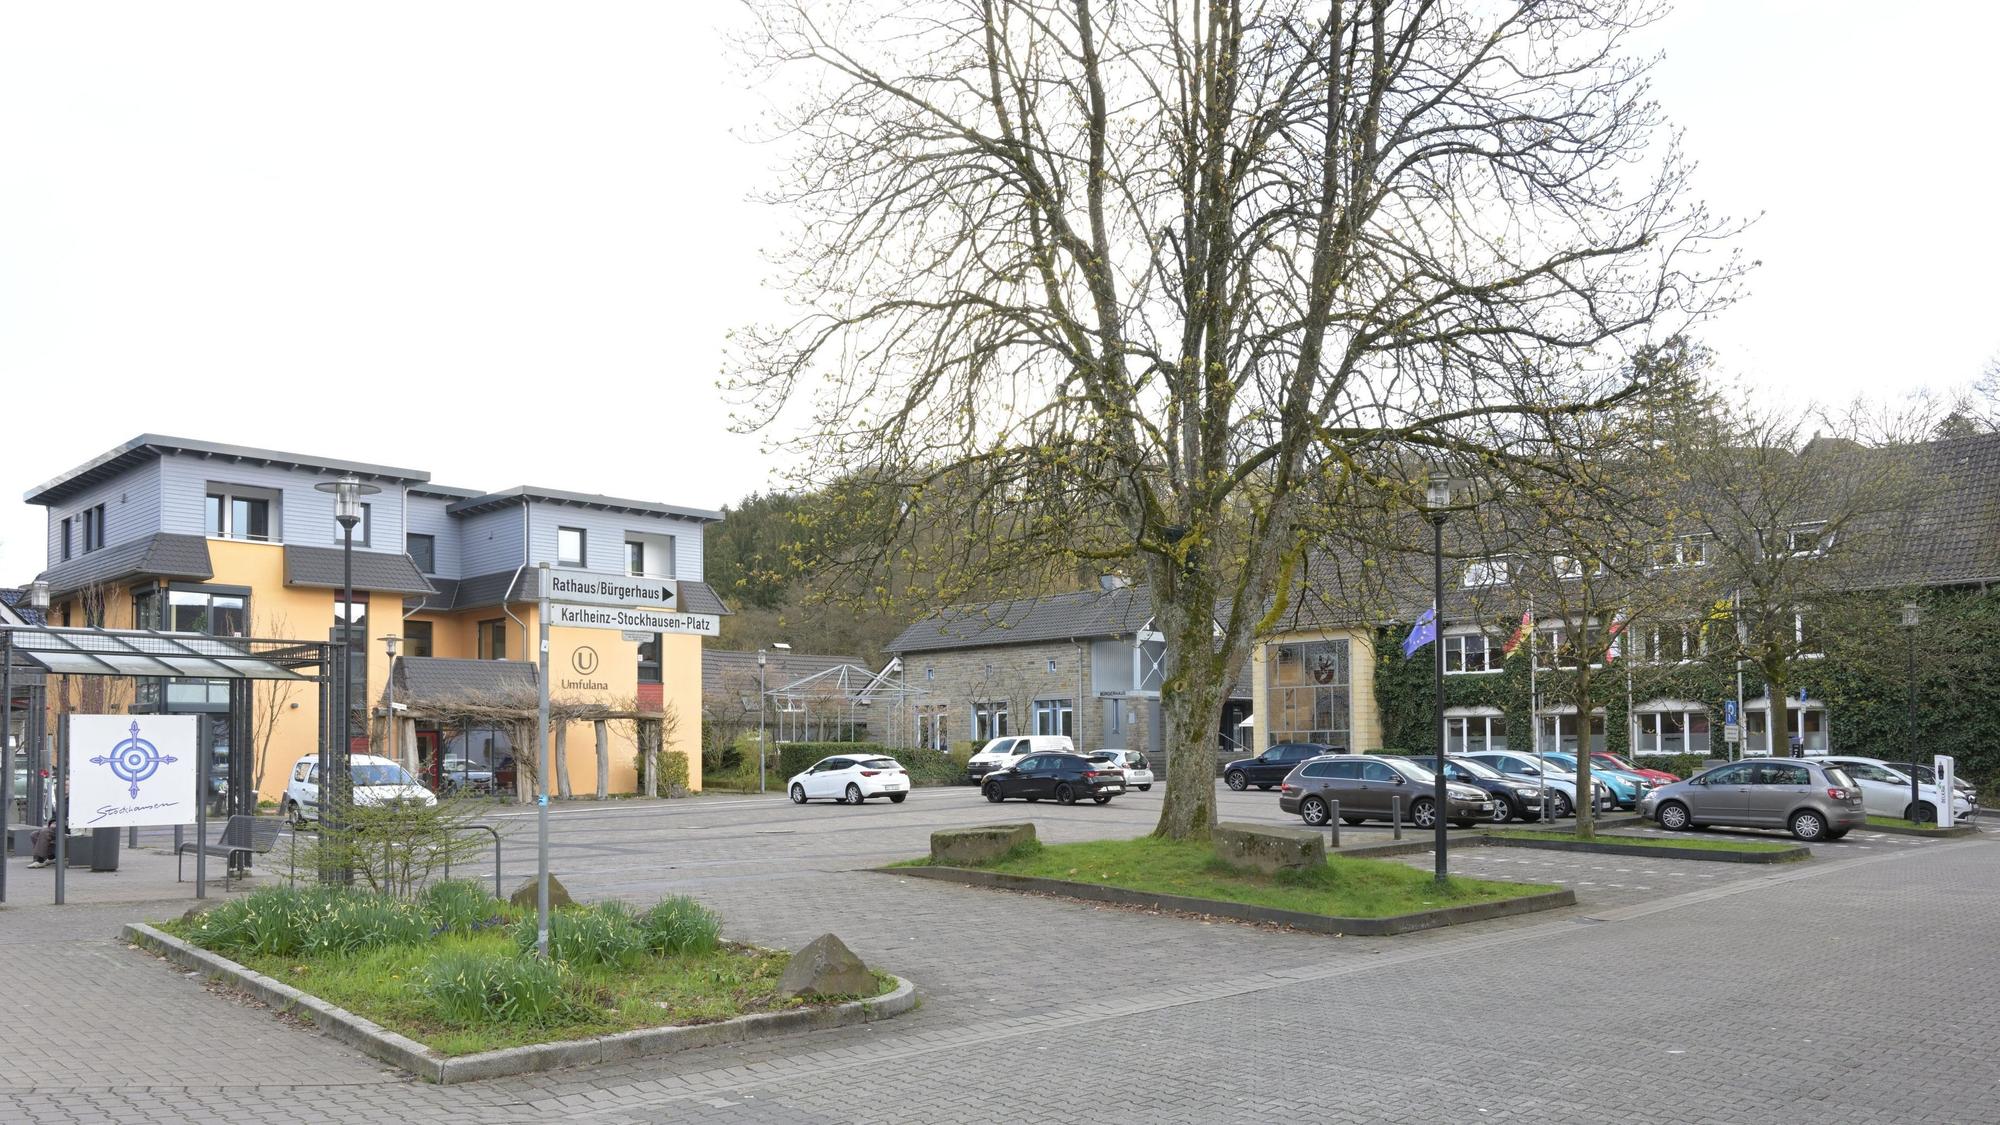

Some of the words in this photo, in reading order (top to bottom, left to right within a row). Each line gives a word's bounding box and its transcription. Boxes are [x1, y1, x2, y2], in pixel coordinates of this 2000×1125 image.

[553, 577, 660, 600] Rathaus/Bürgerhaus
[561, 608, 710, 631] Karlheinz-Stockhausen-Platz
[578, 652, 592, 670] U
[561, 679, 608, 690] Umfulana
[86, 802, 180, 824] Stockhausen
